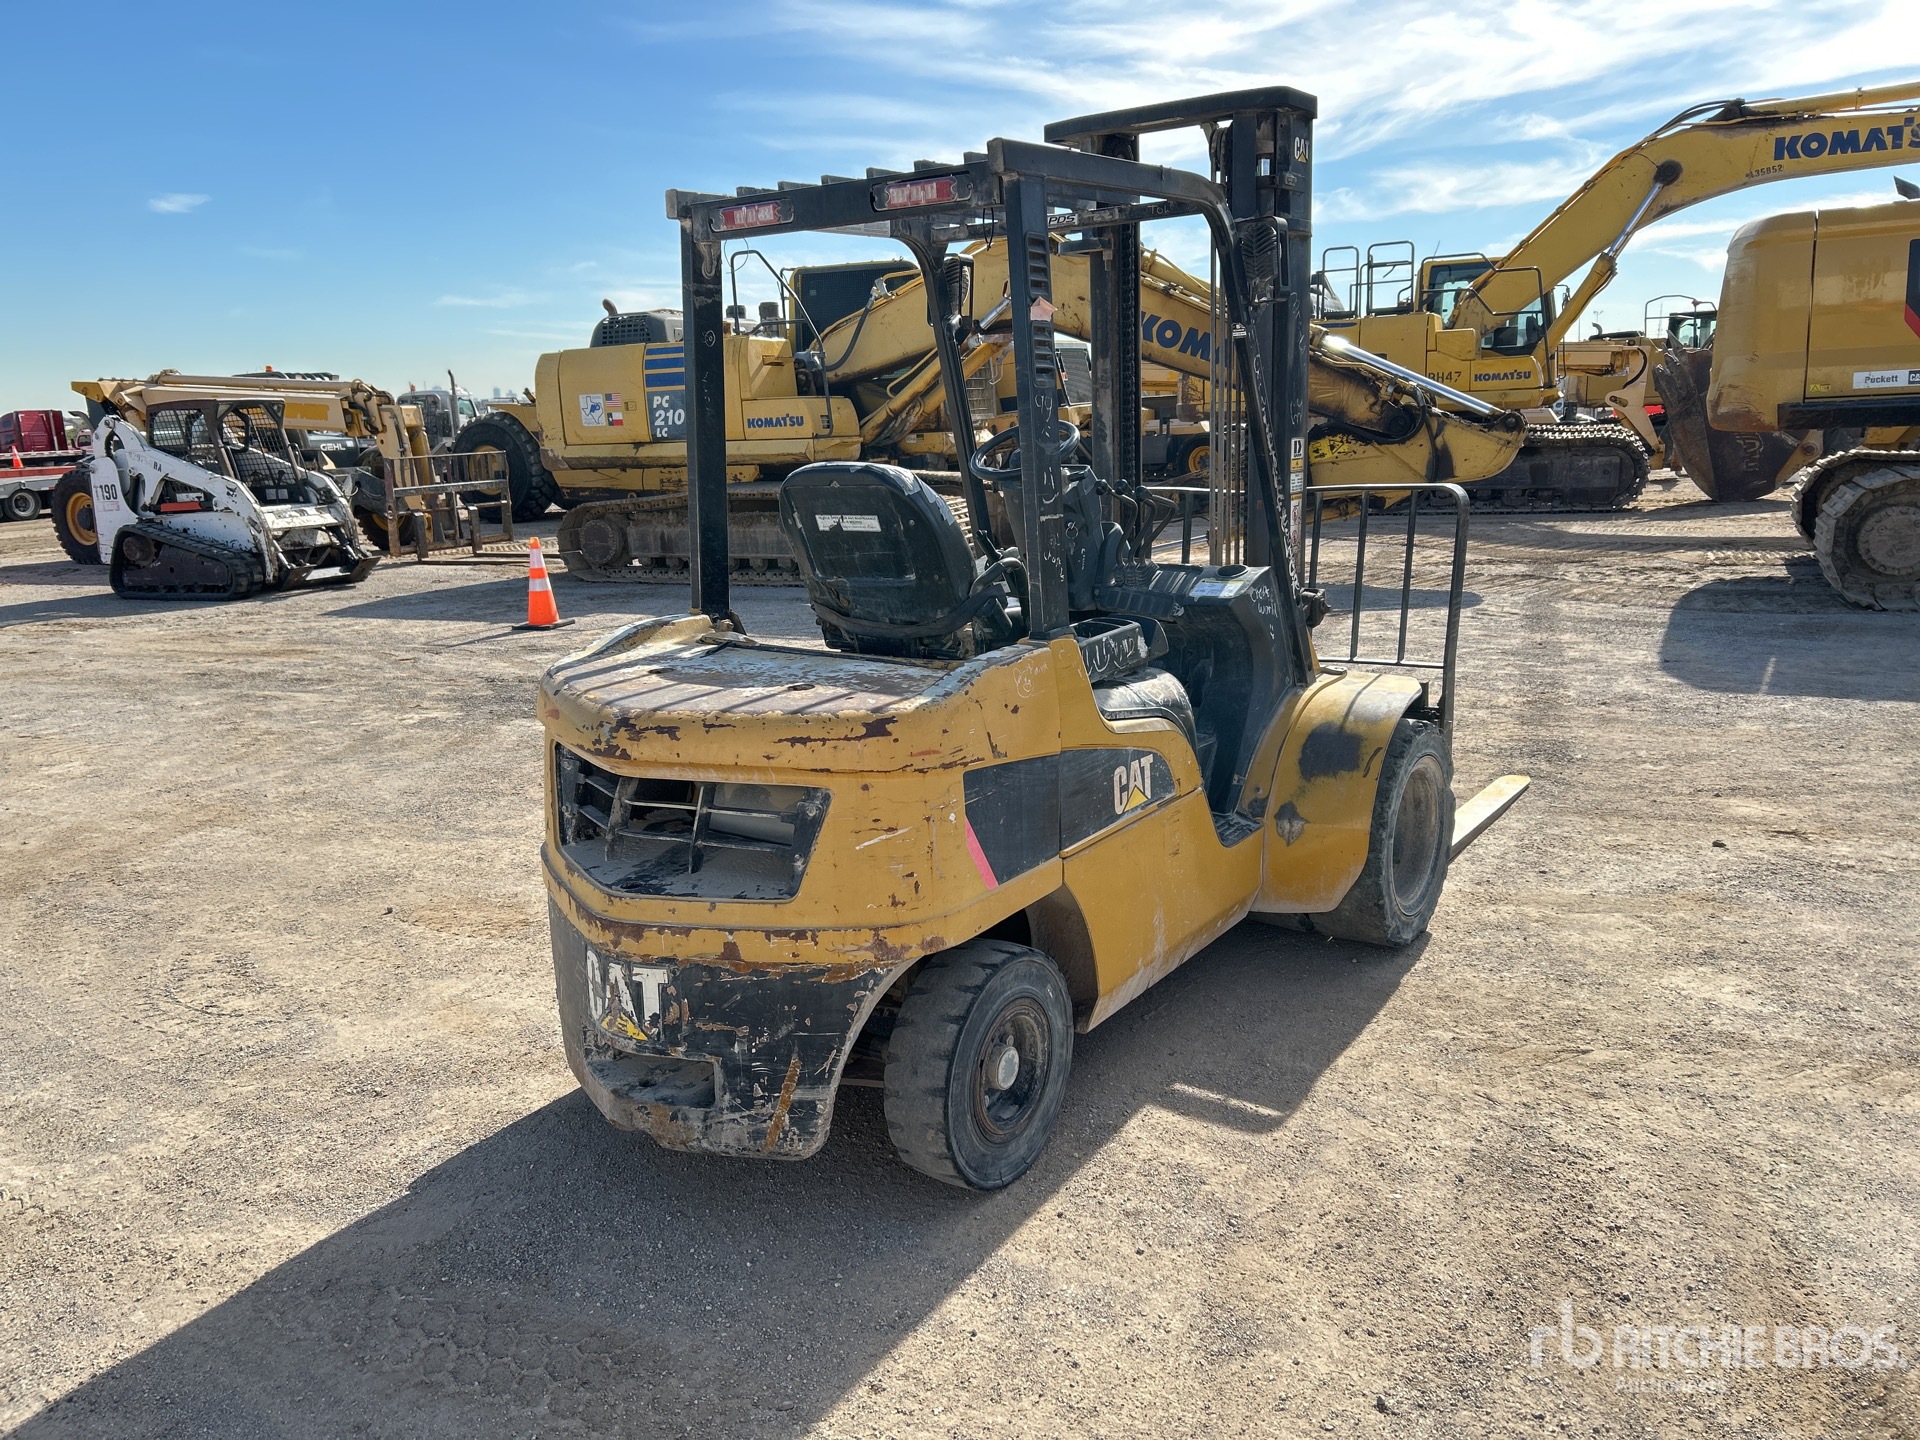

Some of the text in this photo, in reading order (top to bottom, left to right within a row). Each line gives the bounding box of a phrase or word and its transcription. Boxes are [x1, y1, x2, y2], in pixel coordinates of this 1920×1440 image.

[1294, 136, 1310, 162] CAT
[1141, 311, 1221, 366] KOM
[1474, 369, 1531, 382] KOMATSU
[653, 395, 669, 409] PC
[654, 408, 685, 426] 210
[747, 413, 804, 428] KOMATSU
[656, 427, 668, 437] LC
[320, 443, 346, 451] GEHL
[1113, 754, 1153, 814] CAT
[586, 949, 671, 1041] CAT
